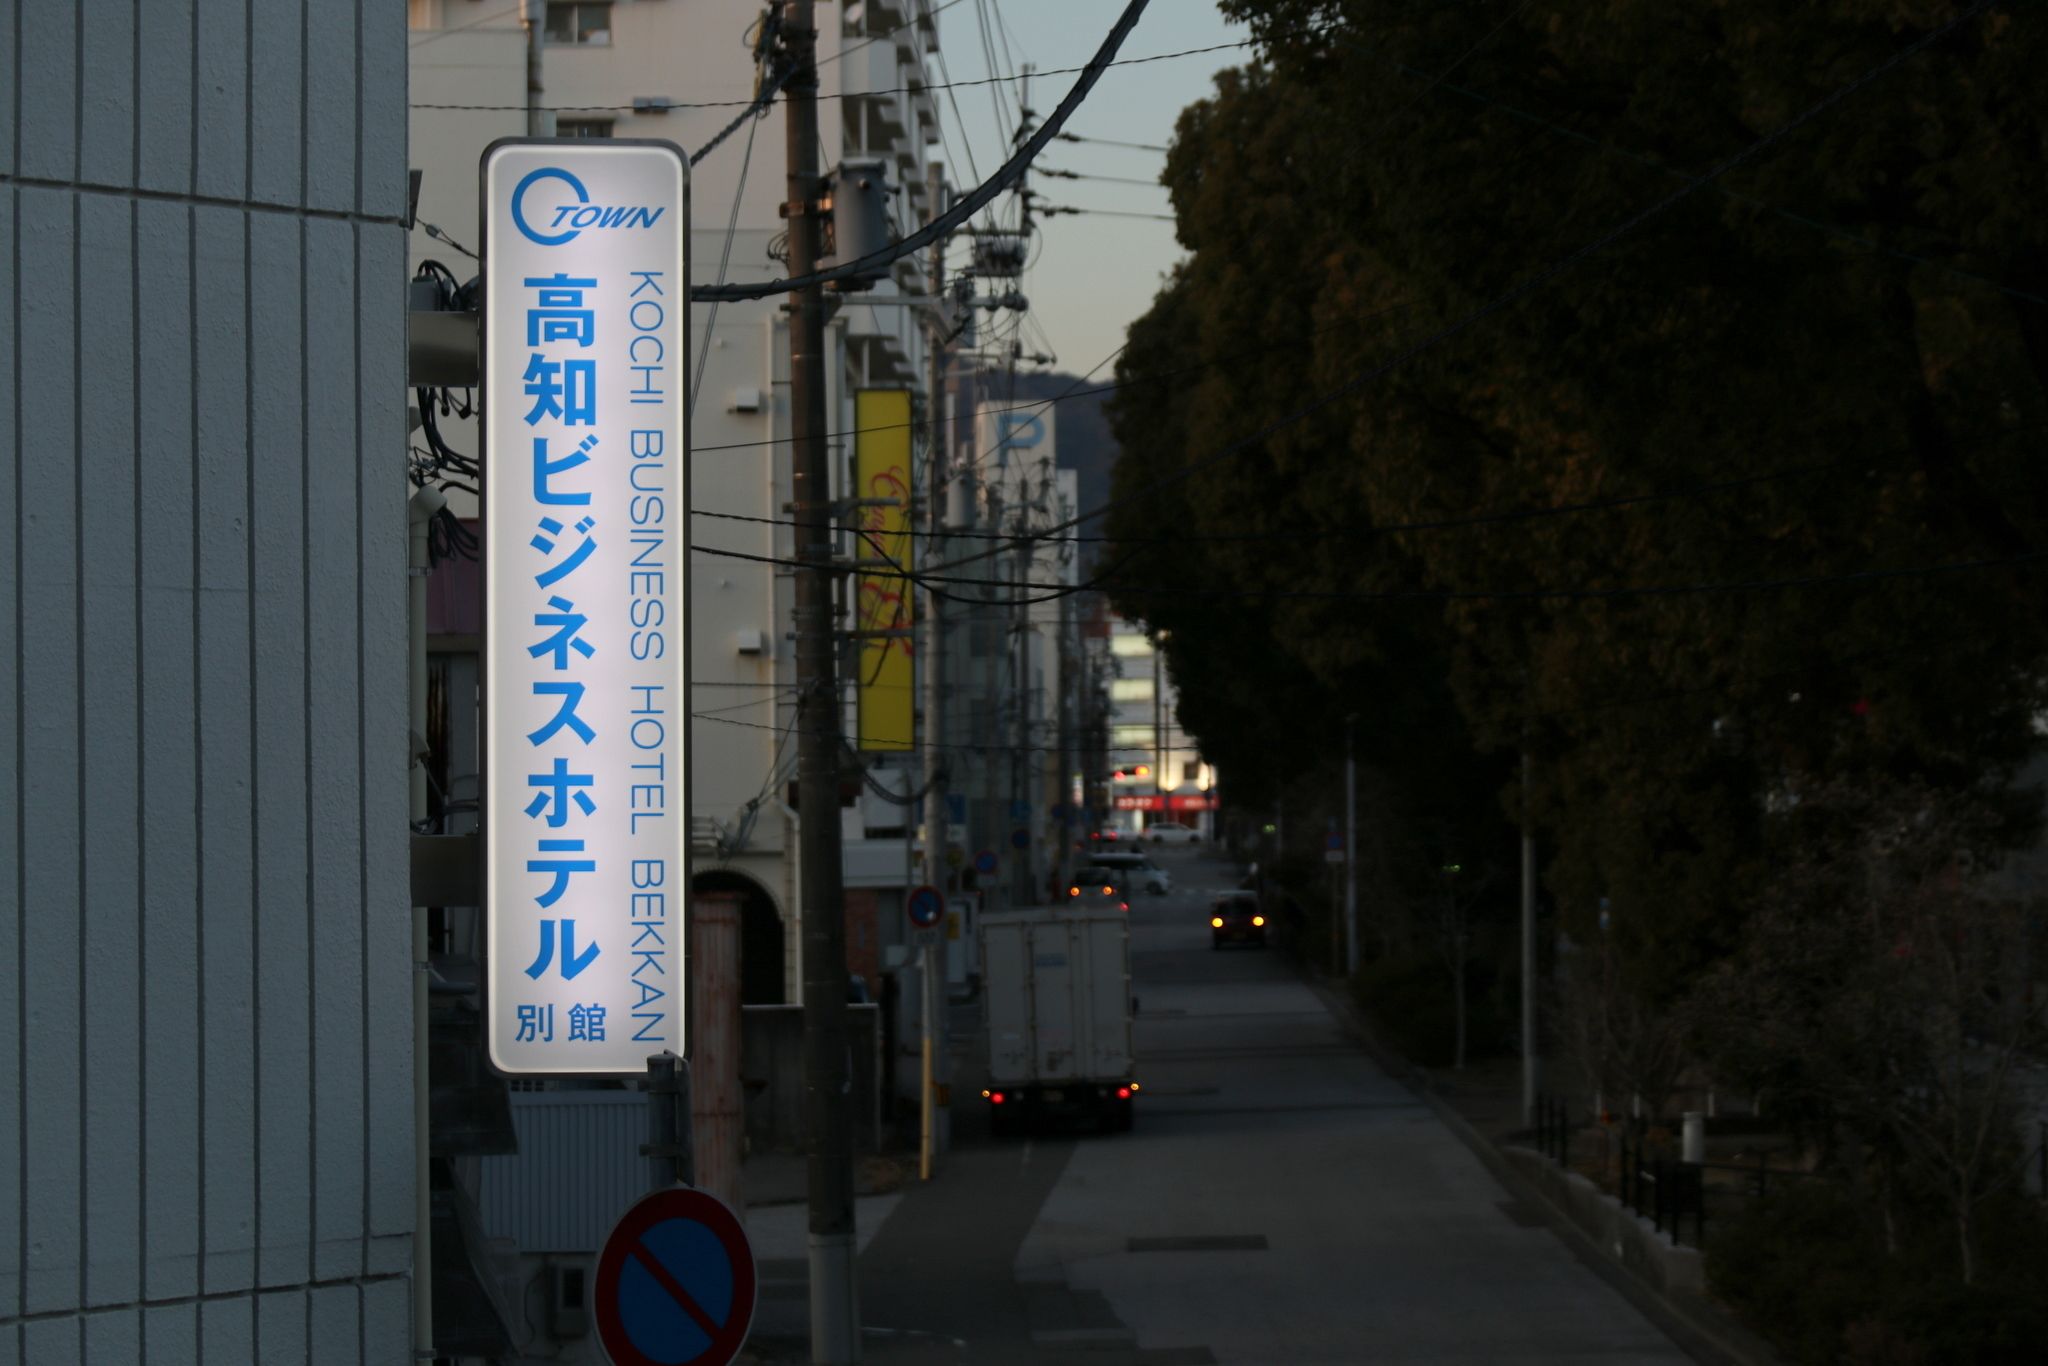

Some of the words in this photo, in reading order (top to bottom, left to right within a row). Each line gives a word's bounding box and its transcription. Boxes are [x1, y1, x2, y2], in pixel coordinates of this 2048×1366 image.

[629, 271, 664, 405] KOCHI
[998, 412, 1045, 467] P
[629, 428, 665, 662] BUSINESS
[523, 273, 602, 982] 高知ビジネスホテル
[630, 684, 666, 834] HOTEL
[515, 1002, 608, 1043] 別館
[630, 859, 667, 1042] BEKKAN
